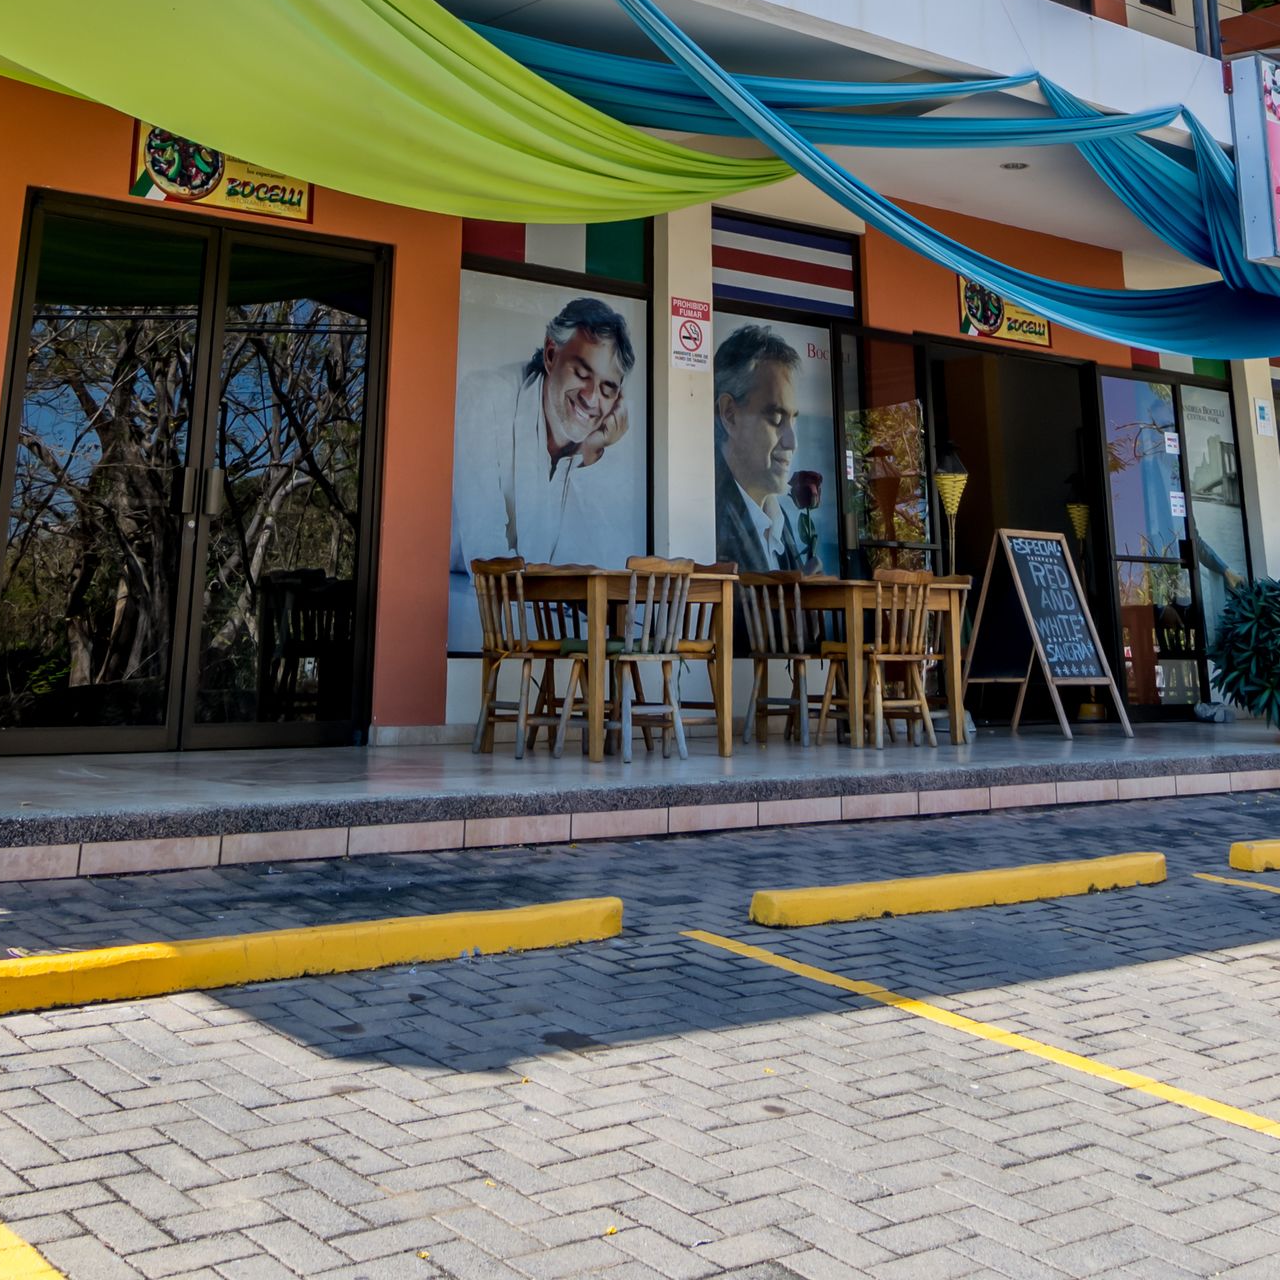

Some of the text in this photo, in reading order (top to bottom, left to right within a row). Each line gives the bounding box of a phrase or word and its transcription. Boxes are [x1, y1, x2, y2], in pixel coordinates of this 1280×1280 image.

[226, 177, 304, 207] BOCELLI
[672, 298, 709, 312] PROHIBIDO
[679, 308, 702, 319] FUMAR
[1006, 317, 1046, 336] BOCELLI
[1028, 561, 1069, 589] RED
[1040, 588, 1075, 611] AND
[1034, 615, 1082, 638] WHITE
[1046, 642, 1090, 663] SANGRIA
